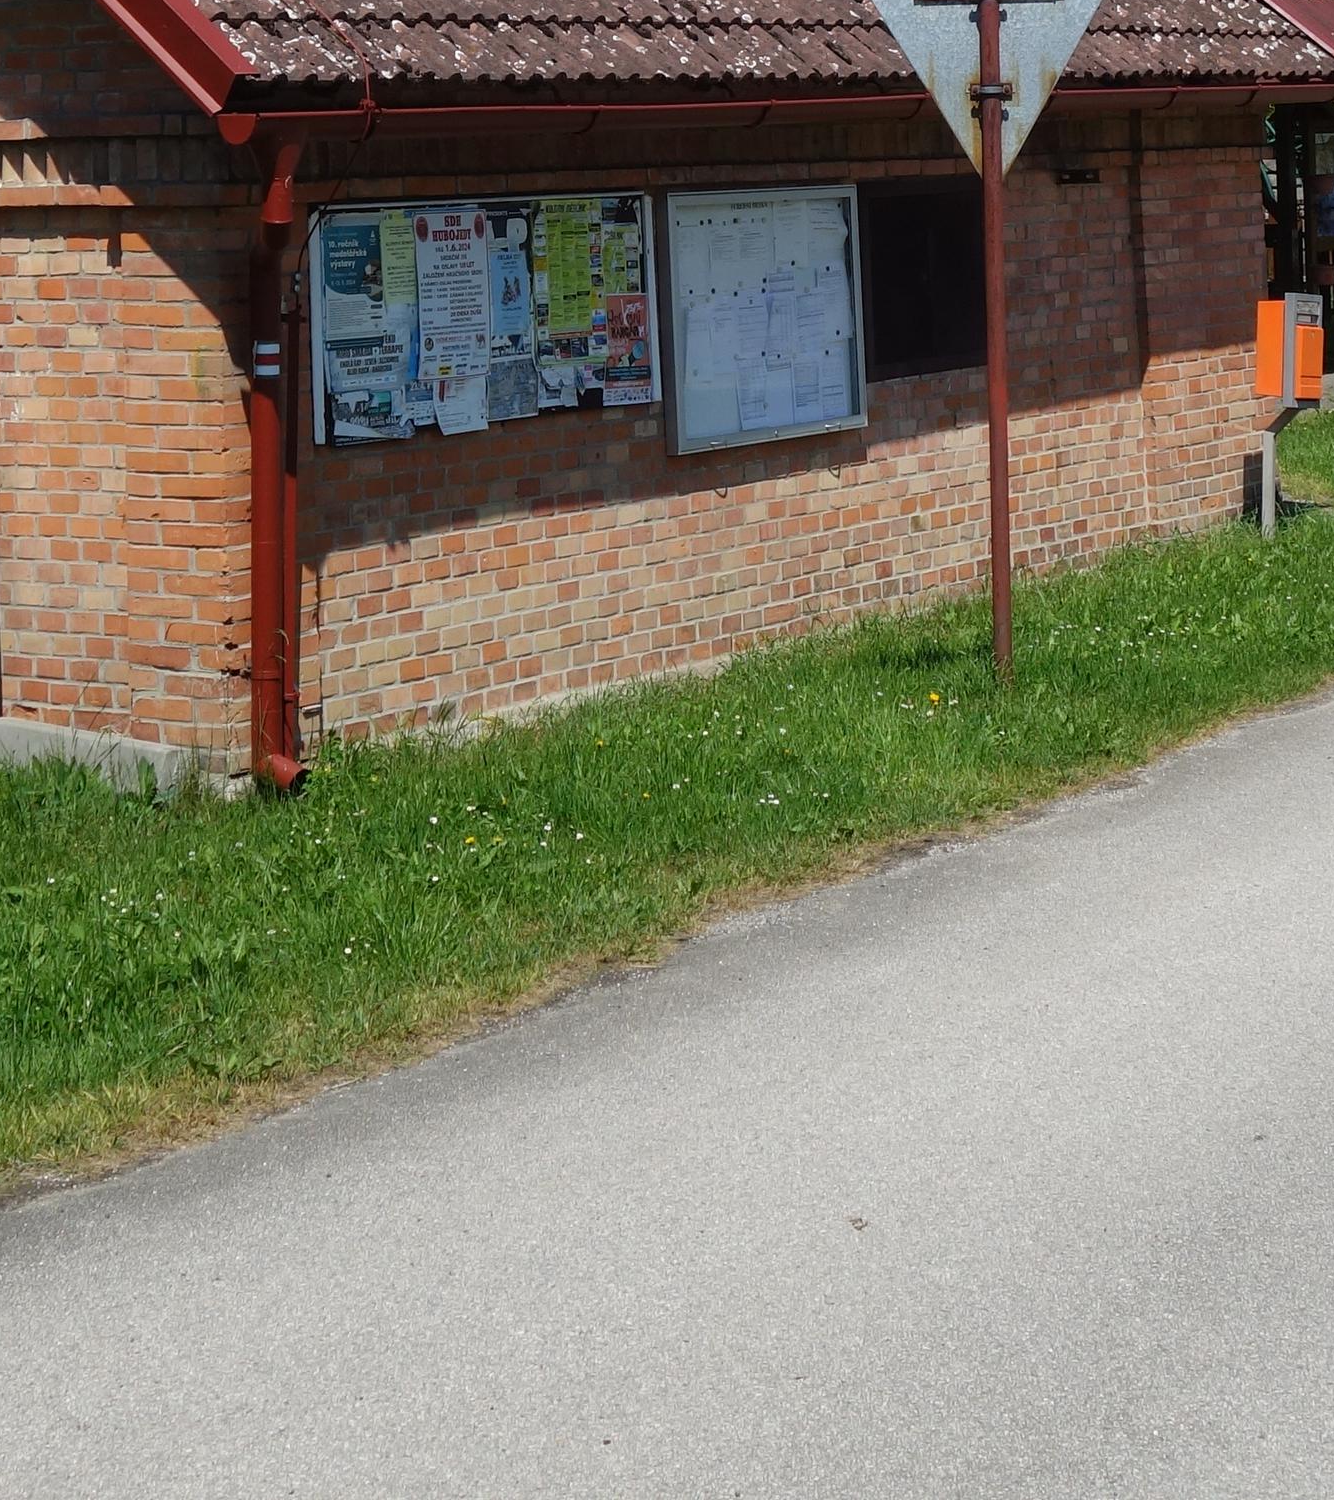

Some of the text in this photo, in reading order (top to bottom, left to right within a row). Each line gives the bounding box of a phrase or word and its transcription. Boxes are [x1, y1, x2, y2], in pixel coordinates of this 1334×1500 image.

[444, 215, 462, 228] SDH
[432, 228, 472, 242] HUBOJEDY
[338, 238, 359, 248] ročník
[445, 242, 471, 252] 1.6.2024
[330, 259, 356, 270] výstavy
